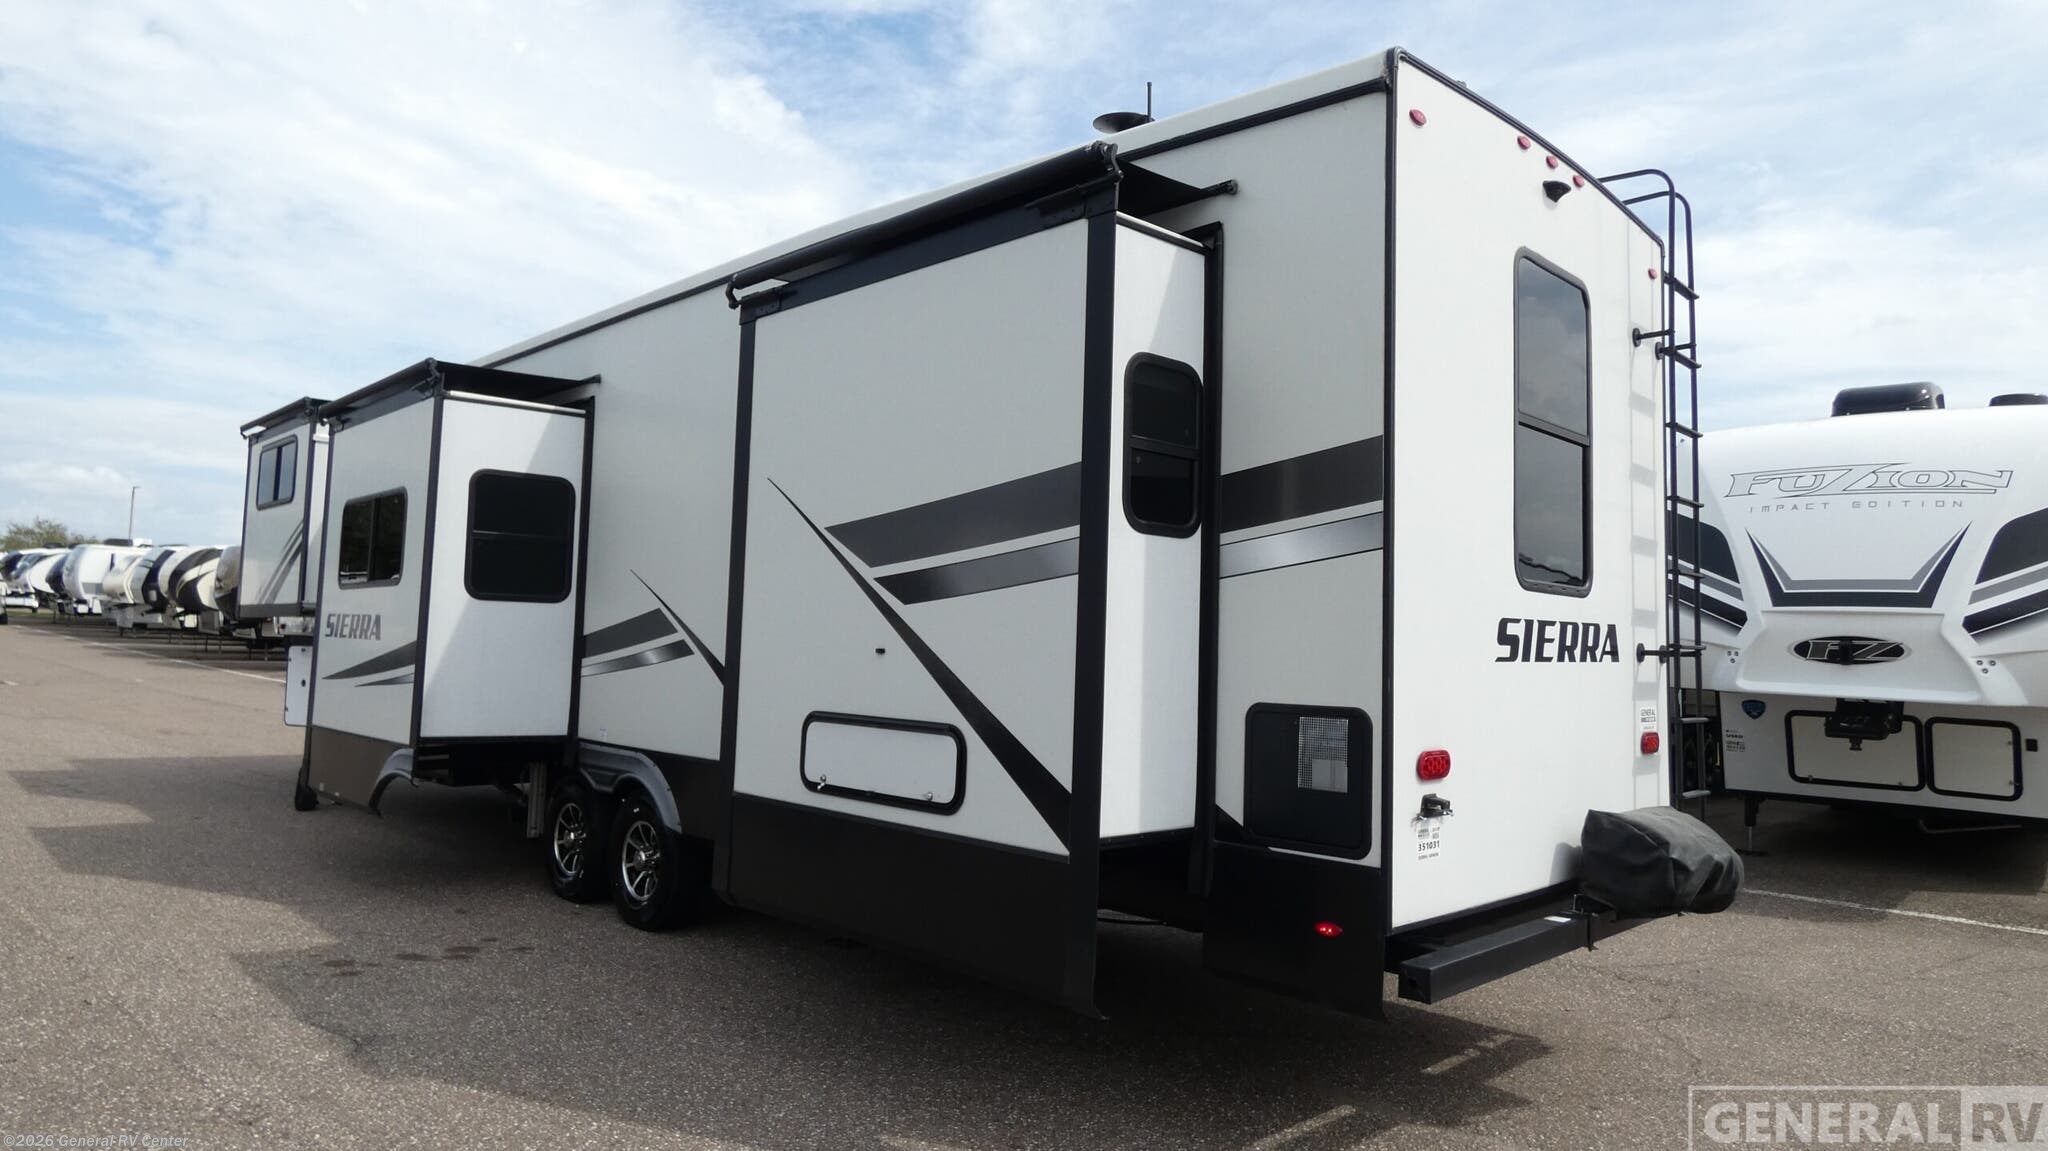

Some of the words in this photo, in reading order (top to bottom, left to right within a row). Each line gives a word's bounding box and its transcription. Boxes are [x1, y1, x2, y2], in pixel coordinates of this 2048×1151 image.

[1750, 502, 1830, 513] IMPACT
[1852, 500, 1963, 509] EDITION
[325, 613, 381, 641] SIERRA
[1495, 617, 1619, 662] SIERRA
